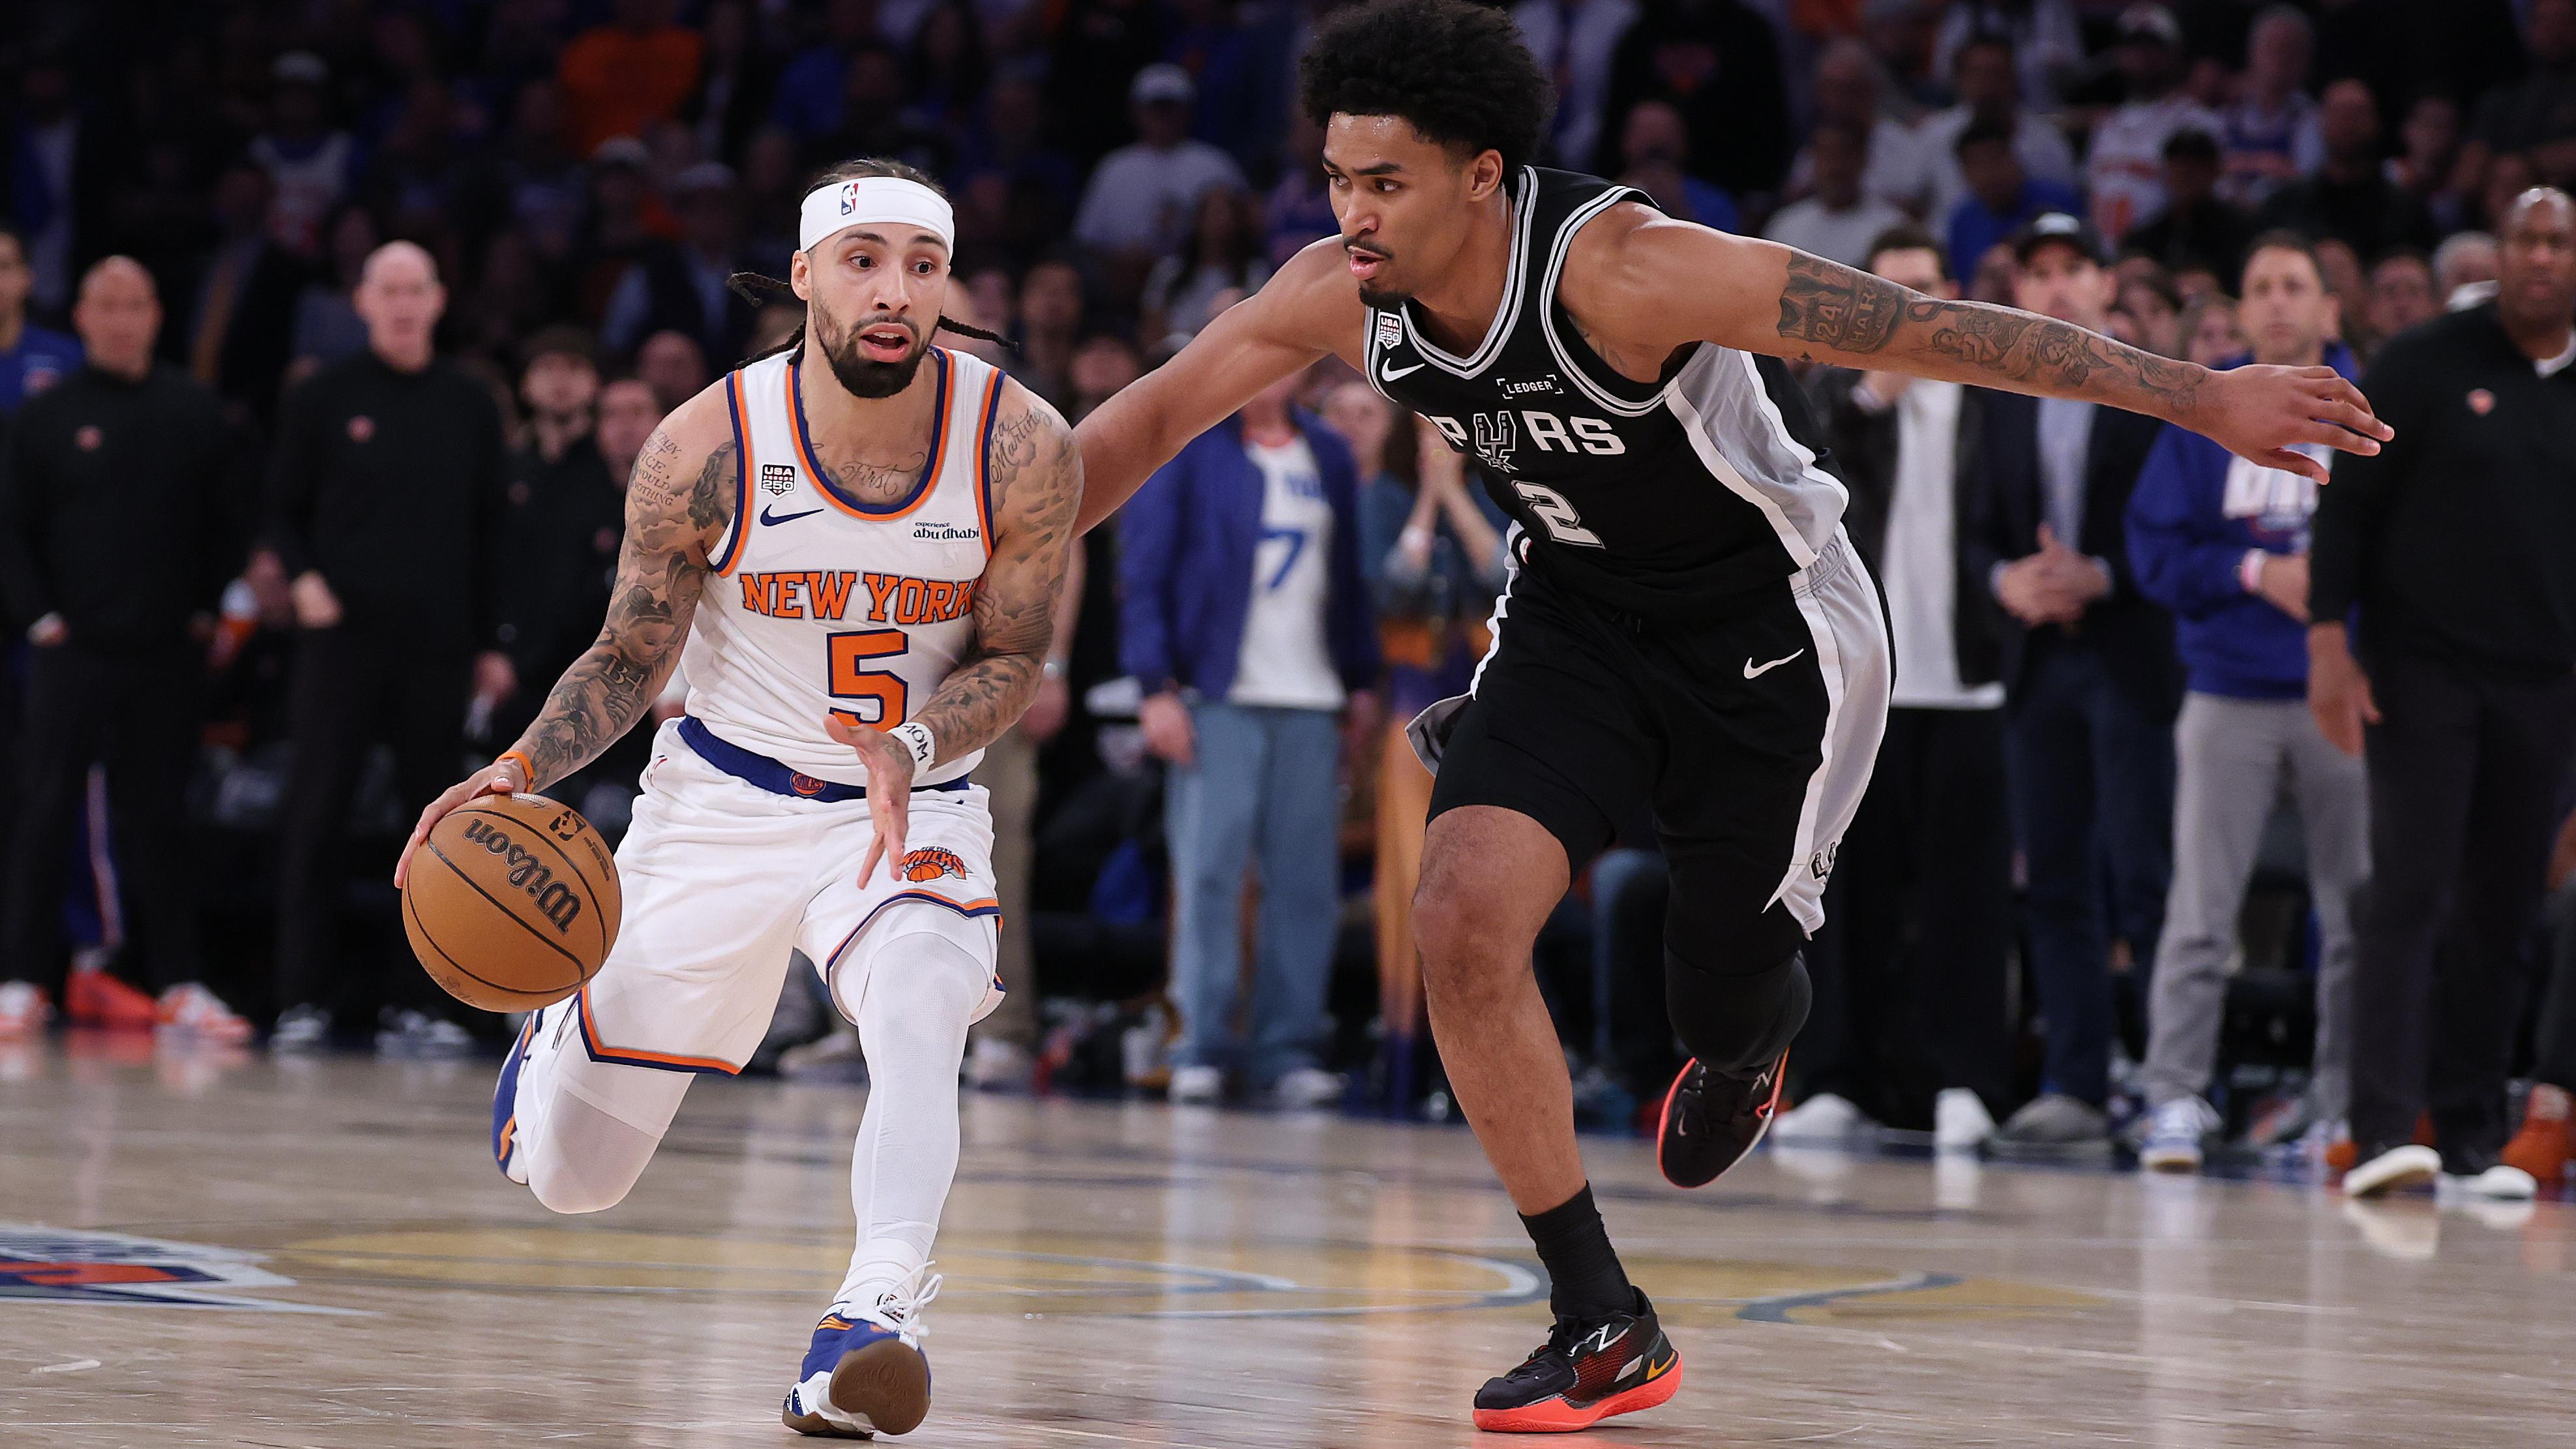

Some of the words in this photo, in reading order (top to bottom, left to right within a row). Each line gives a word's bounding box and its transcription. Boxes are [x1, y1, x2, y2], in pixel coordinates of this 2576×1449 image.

[1381, 317, 1399, 328] USA
[1380, 330, 1399, 342] 250
[1506, 381, 1553, 393] LEDGER
[764, 466, 793, 476] USA
[762, 480, 793, 490] 250
[1511, 479, 1606, 549] 2
[913, 528, 940, 539] abu
[942, 527, 980, 539] dhabi
[739, 571, 856, 621] NEW
[864, 574, 979, 625] YORK
[826, 629, 909, 732] 5
[902, 850, 966, 880] KNICKS
[462, 818, 582, 935] Wilson
